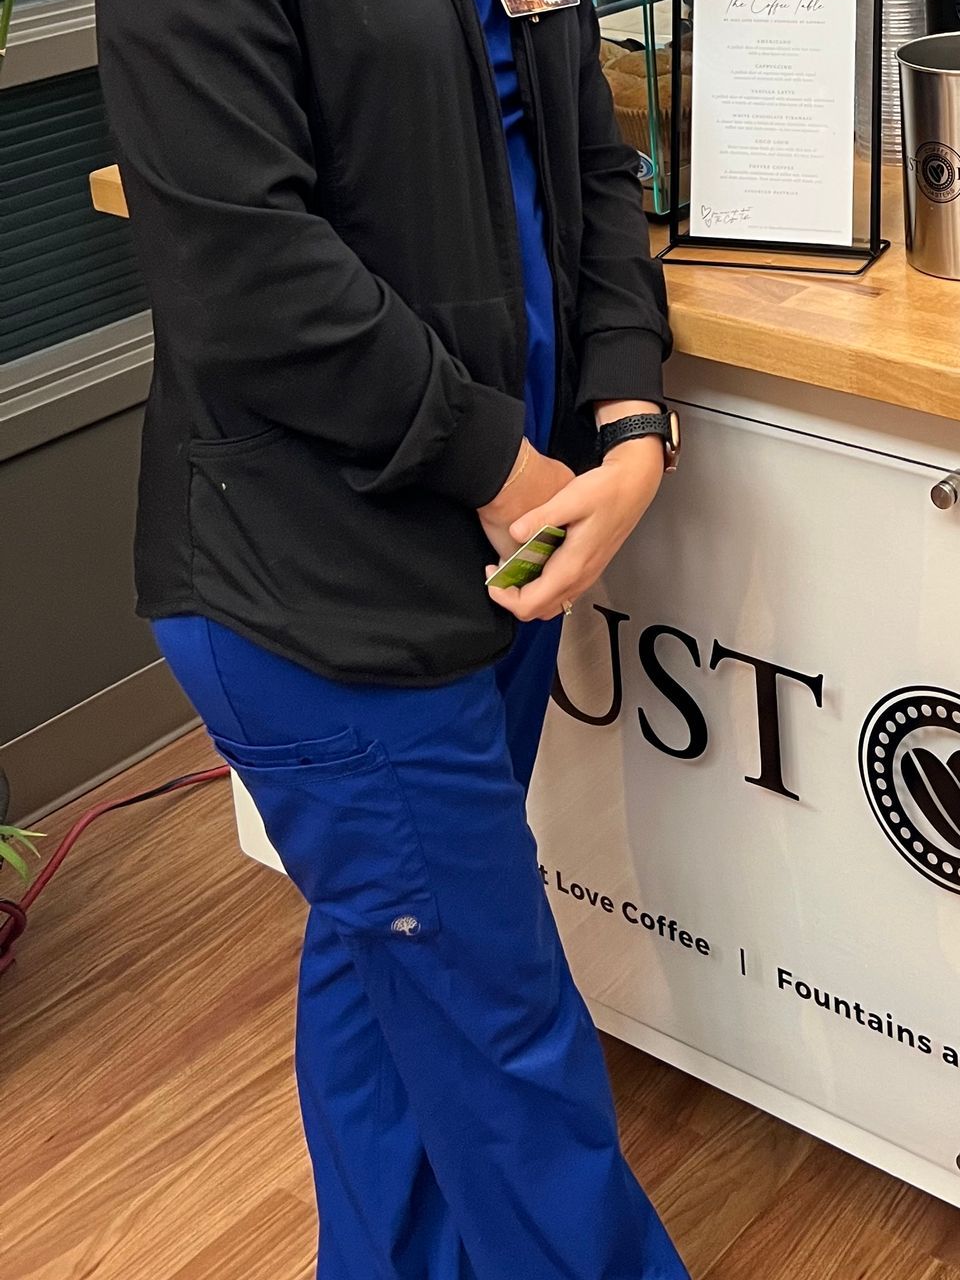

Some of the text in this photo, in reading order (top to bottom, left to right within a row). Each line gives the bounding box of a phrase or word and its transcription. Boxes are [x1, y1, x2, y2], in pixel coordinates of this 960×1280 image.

[550, 603, 824, 802] UST
[556, 870, 615, 915] Love
[621, 901, 711, 956] Coffee
[777, 967, 932, 1054] Fountains
